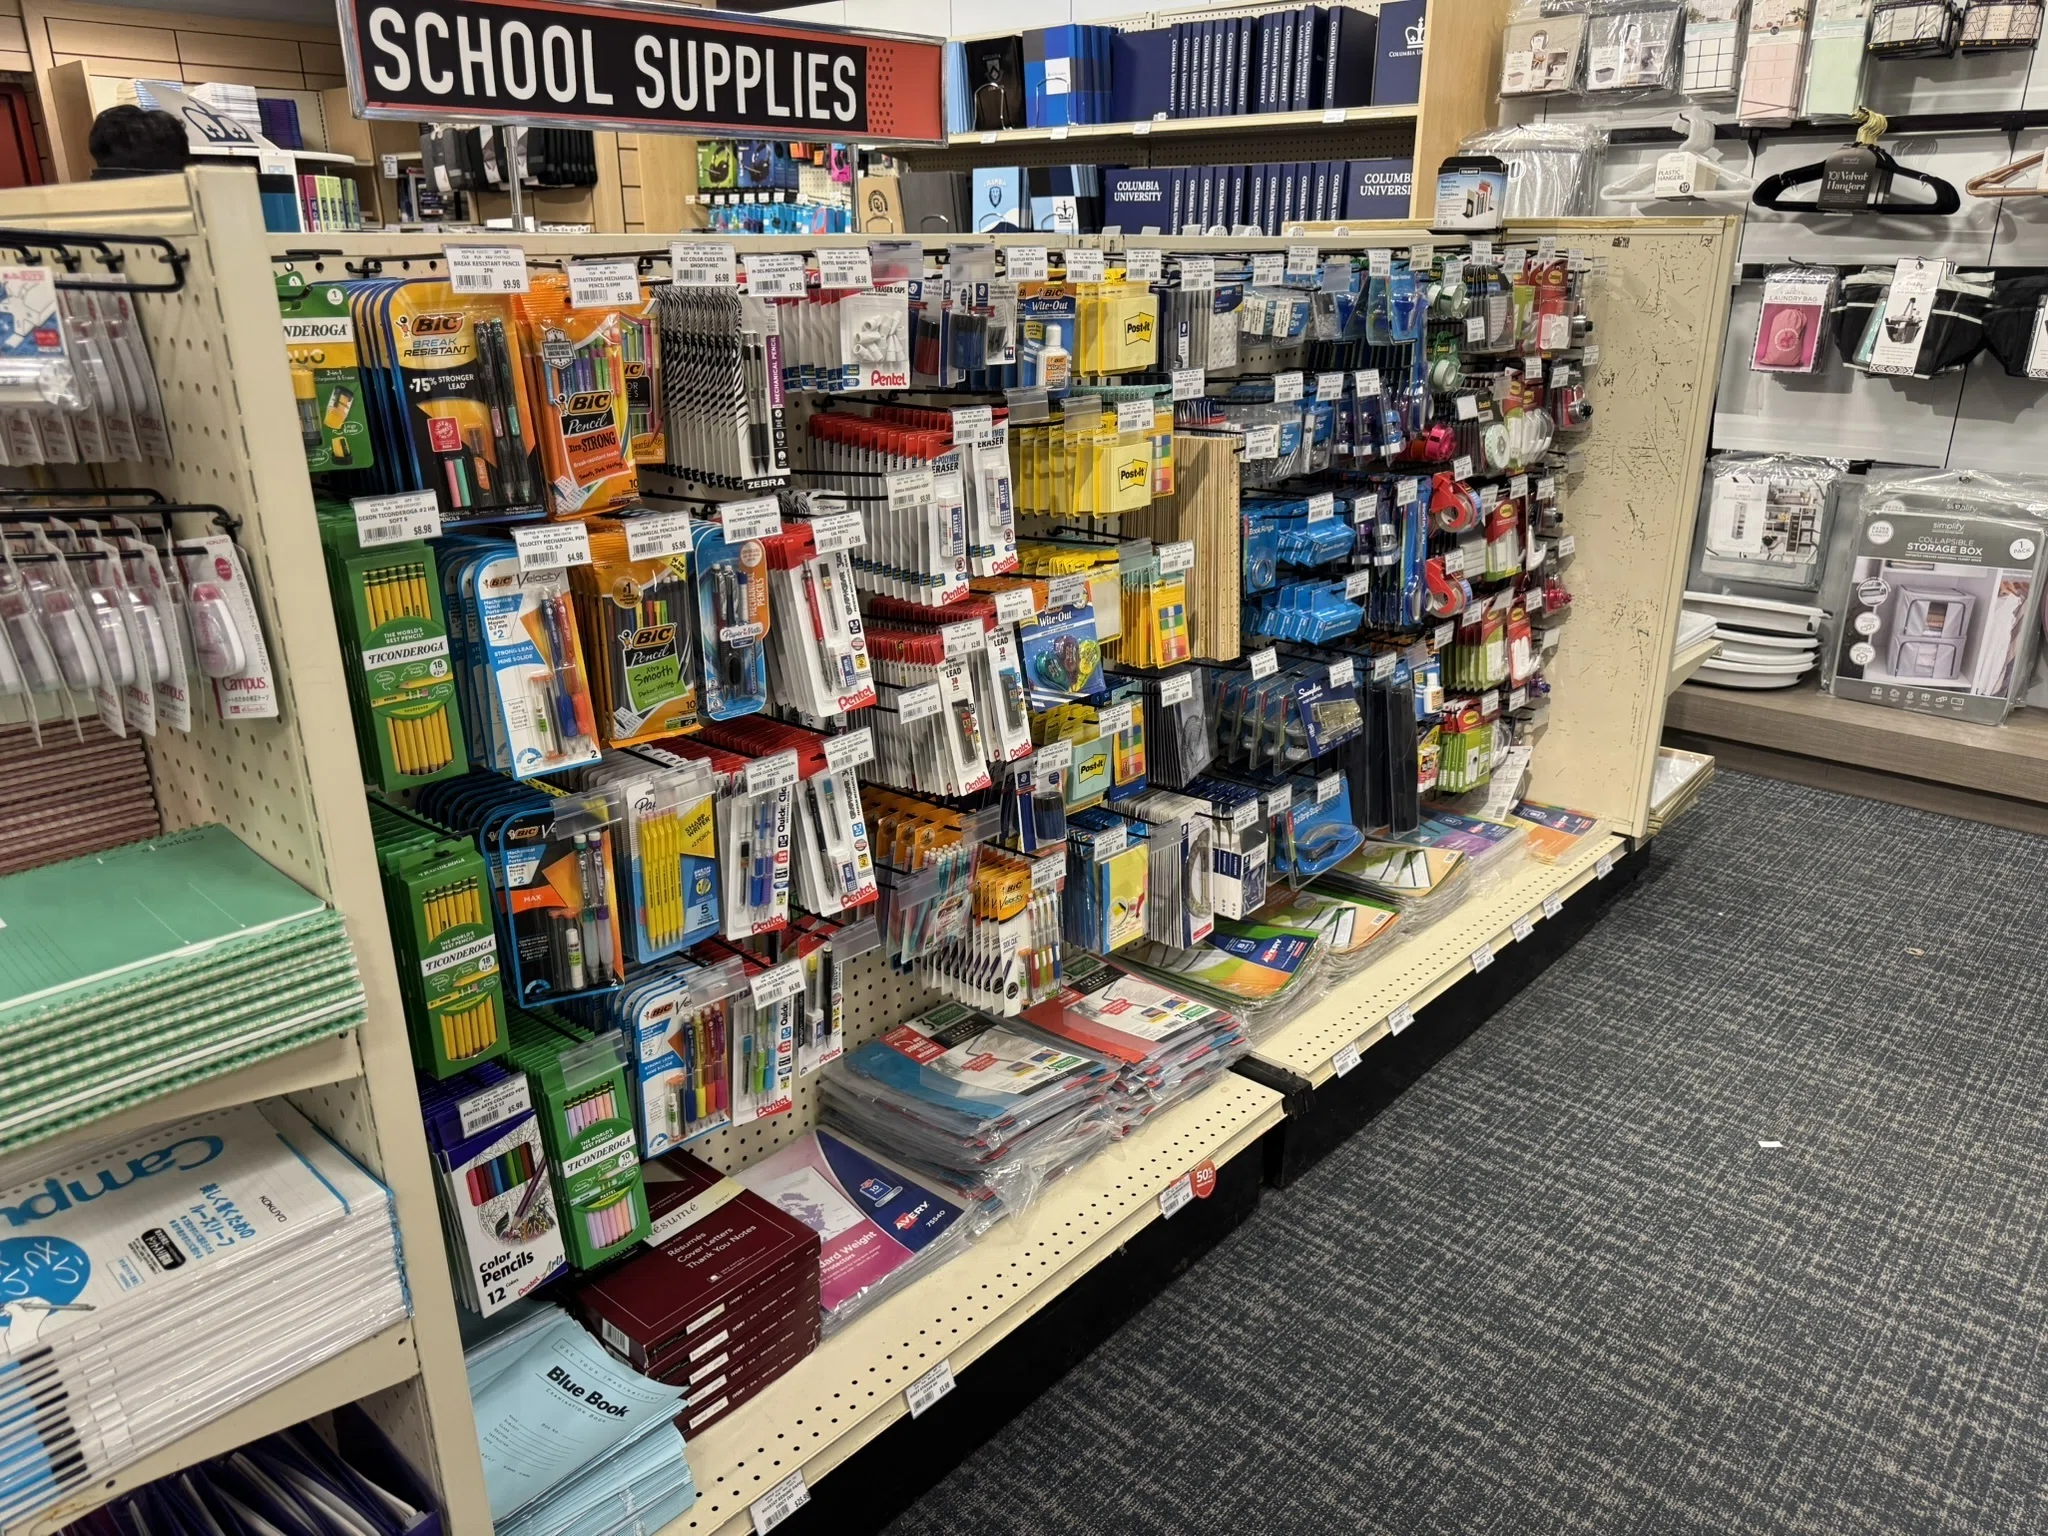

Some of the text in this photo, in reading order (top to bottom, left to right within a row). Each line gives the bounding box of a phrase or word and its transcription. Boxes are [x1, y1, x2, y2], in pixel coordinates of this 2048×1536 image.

[369, 7, 857, 122] SCHOOL SUPPLIES
[1117, 181, 1160, 191] COLUMBIA
[1826, 182, 1866, 193] Hangers
[1114, 192, 1162, 201] UNIVERSITY
[503, 279, 521, 289] $9.98
[875, 286, 906, 294] ERASER CAPS
[617, 292, 632, 302] $5.98
[403, 345, 470, 357] RESISTANT
[413, 338, 457, 349] BREAK
[770, 336, 782, 403] MECHANICAL PENCIL
[871, 370, 907, 386] Pentel
[438, 374, 474, 384] STRONGER
[448, 382, 466, 390] LEAD
[568, 412, 608, 436] Pencil
[581, 432, 616, 452] STRONG
[932, 462, 960, 474] ERASER
[629, 478, 638, 488] 10
[746, 478, 786, 490] ZEBRA
[358, 509, 418, 522] DIXON TICONDEROGA
[414, 524, 432, 536] $8.98
[1932, 521, 1965, 531] simplify
[518, 537, 572, 548] VELOCITY MECHANICAL
[672, 540, 687, 552] $5.98
[1906, 542, 1983, 556] STORAGE BOX
[568, 552, 584, 562] $4.98
[992, 552, 1017, 574] Pentel
[516, 572, 561, 589] Velocity
[756, 576, 766, 608] PENCILS
[942, 583, 969, 605] Pentel
[398, 627, 423, 636] WORLD'S
[400, 632, 424, 641] PENCIL
[994, 637, 1008, 647] LEAD
[368, 642, 444, 664] TICONDEROGA
[494, 648, 517, 657] STRONG
[512, 654, 534, 662] SOLIDE
[631, 646, 670, 668] Pencil
[433, 660, 443, 670] 18
[946, 668, 962, 678] LEAD
[222, 676, 267, 694] Campus
[634, 666, 674, 688] Smooth
[686, 700, 696, 710] 10
[838, 685, 874, 710] Pentel
[591, 750, 598, 758] 2
[1010, 739, 1030, 760] Pentel
[1080, 760, 1104, 775] Post-it
[965, 772, 990, 794] Pentel
[685, 813, 706, 834] SHARP
[688, 815, 710, 838] WRITER
[778, 806, 786, 833] Quick
[524, 894, 542, 903] MAX
[840, 882, 876, 908] Pentel
[701, 904, 709, 914] 5
[752, 912, 784, 934] Pentel
[426, 939, 492, 972] TICONDEROGA
[1262, 938, 1282, 963] AVERY
[482, 956, 490, 965] 18
[610, 978, 618, 987] 2
[780, 1003, 788, 1026] Quick
[819, 1048, 840, 1064] Pentel
[463, 1108, 480, 1118] PENTEL
[492, 1092, 514, 1106] COLORED
[508, 1101, 524, 1114] $5.98
[756, 1095, 788, 1118] Pentel
[580, 1128, 614, 1148] THE WORLD'S
[592, 1132, 614, 1146] PENCIL
[567, 1135, 632, 1172] TICONDEROGA
[622, 1152, 630, 1160] 10
[600, 1189, 616, 1199] PASTEL
[200, 1182, 257, 1240] 美しく書くための
[259, 1195, 288, 1223] KOKUYO
[896, 1200, 928, 1230] AVERY
[190, 1204, 236, 1247] ルーズリーフ
[926, 1210, 946, 1228] 75540
[667, 1232, 707, 1257] Résumés
[677, 1227, 734, 1263] Cover Letters
[686, 1251, 715, 1270] Thank
[712, 1240, 732, 1254] You
[730, 1225, 758, 1243] Notes
[839, 1231, 878, 1254] Weight
[480, 1251, 512, 1274] Color
[482, 1252, 535, 1288] Pencils
[488, 1278, 520, 1306] 12 Colors
[517, 1276, 540, 1296] Pentel
[579, 1359, 599, 1375] YOUR
[546, 1365, 630, 1418] Blue Book
[546, 1388, 586, 1414] EXAMINATION
